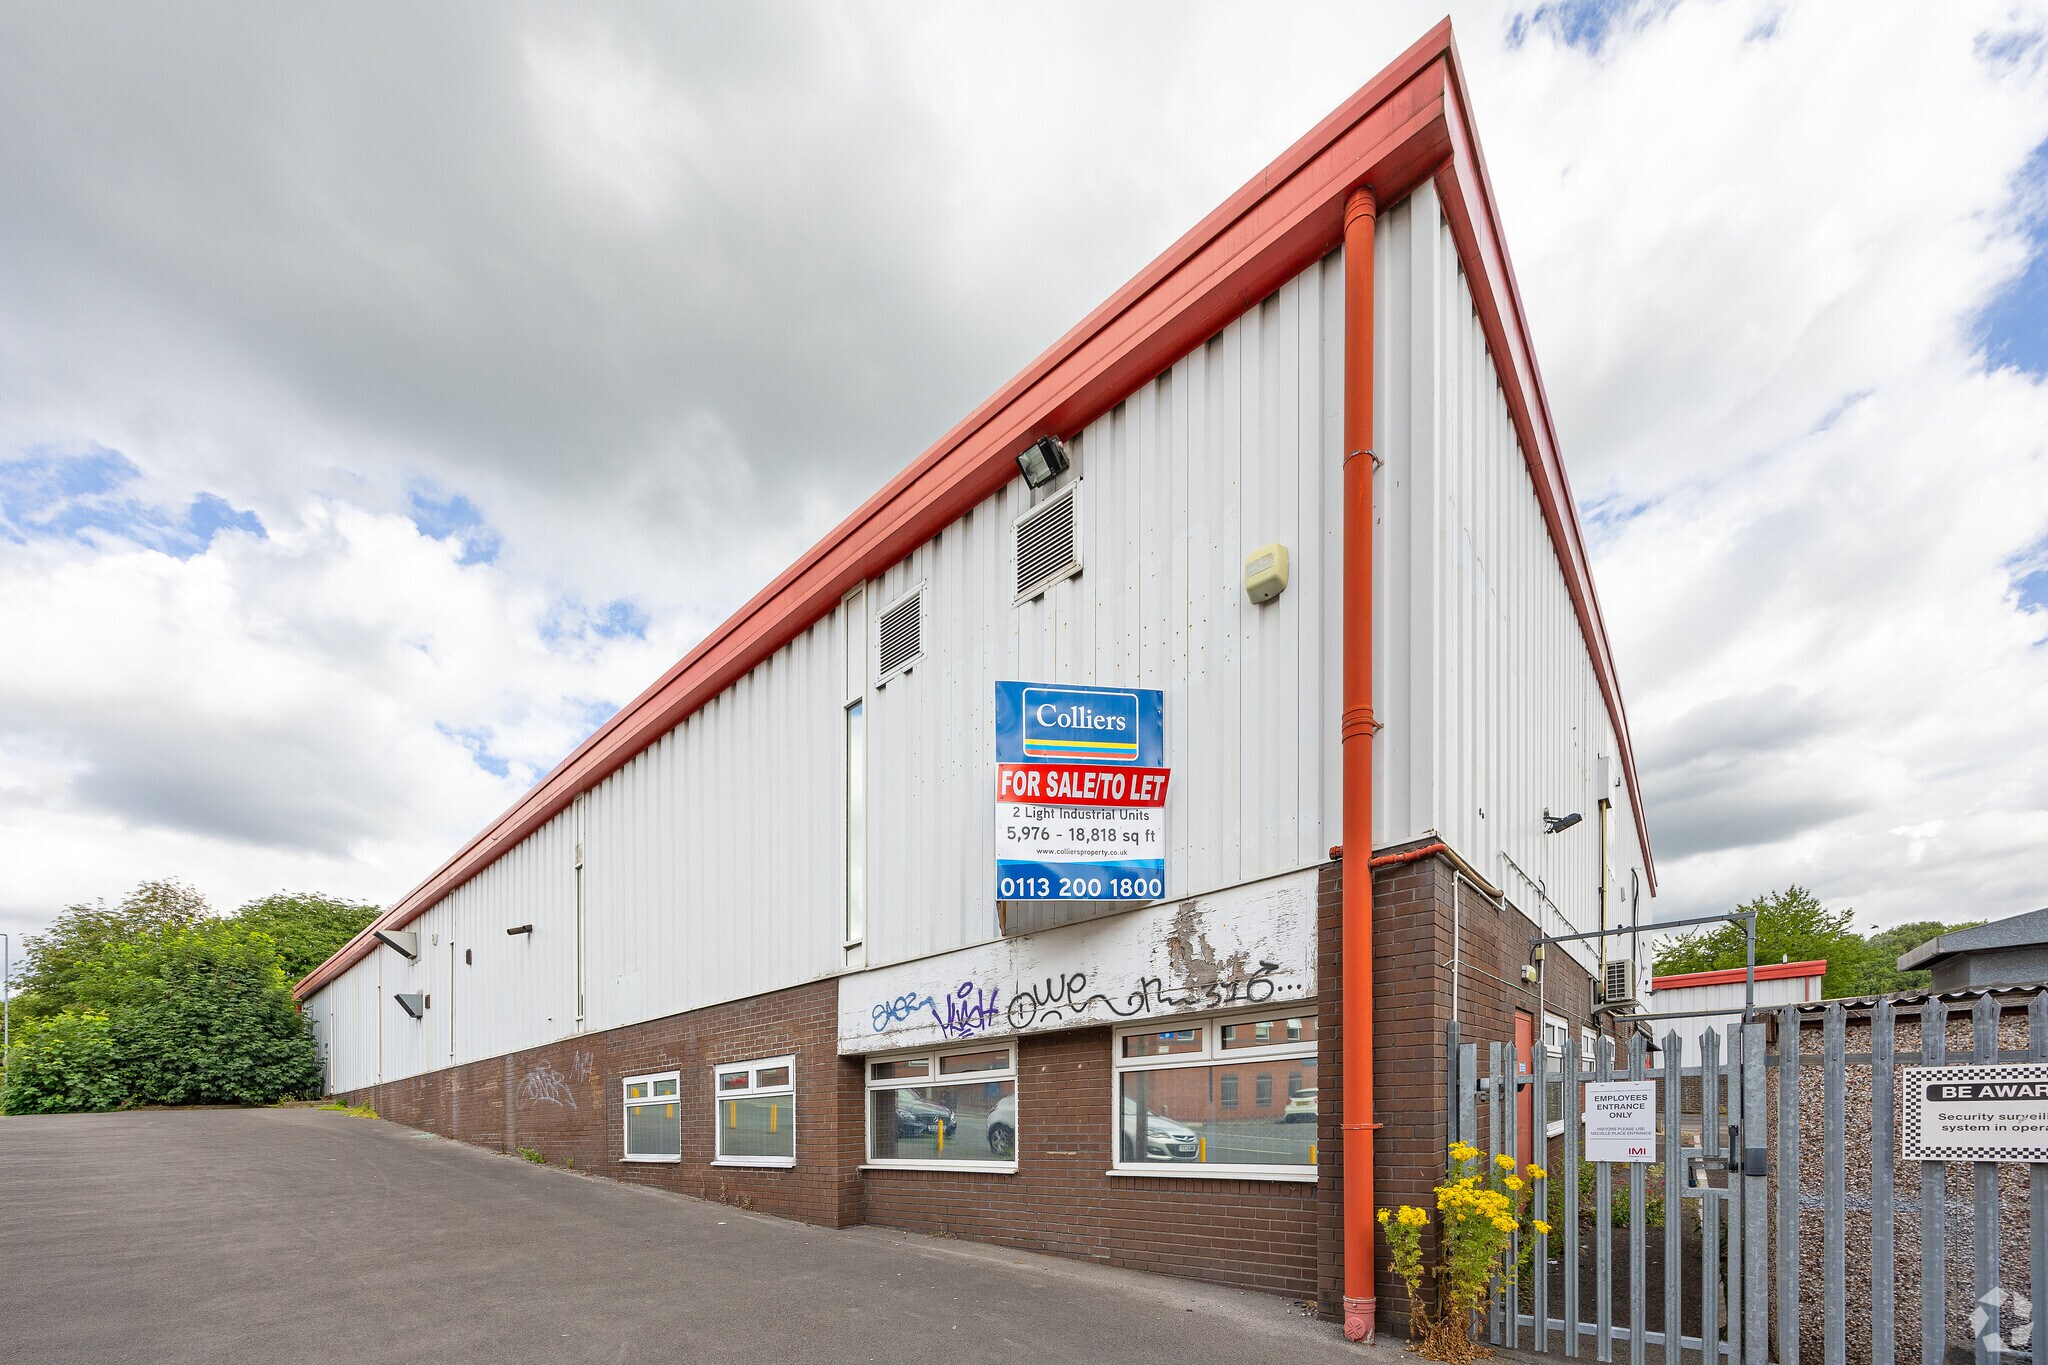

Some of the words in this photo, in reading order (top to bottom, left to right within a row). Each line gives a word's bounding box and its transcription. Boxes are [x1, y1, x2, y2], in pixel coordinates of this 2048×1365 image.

[1036, 703, 1127, 731] Colliers
[1001, 770, 1041, 797] FOR
[1046, 771, 1126, 801] SALE/TO
[1130, 775, 1165, 801] LET
[1012, 807, 1021, 818] 2
[1025, 807, 1055, 821] Light
[1059, 808, 1116, 821] Industrial
[1119, 810, 1150, 821] Units
[1007, 826, 1050, 843] 5,976
[1069, 828, 1117, 844] 18,818
[1122, 832, 1140, 845] sq
[1145, 829, 1155, 842] ft
[1036, 848, 1128, 857] www.colliersproperty.co.uk
[1000, 877, 1050, 897] 0113
[1059, 878, 1102, 897] 200
[1110, 878, 1162, 897] 1800
[1594, 1094, 1648, 1102] EMPLOYEES
[1942, 1086, 1972, 1099] BE
[1938, 1113, 1994, 1121] Security
[1942, 1124, 1990, 1132] system
